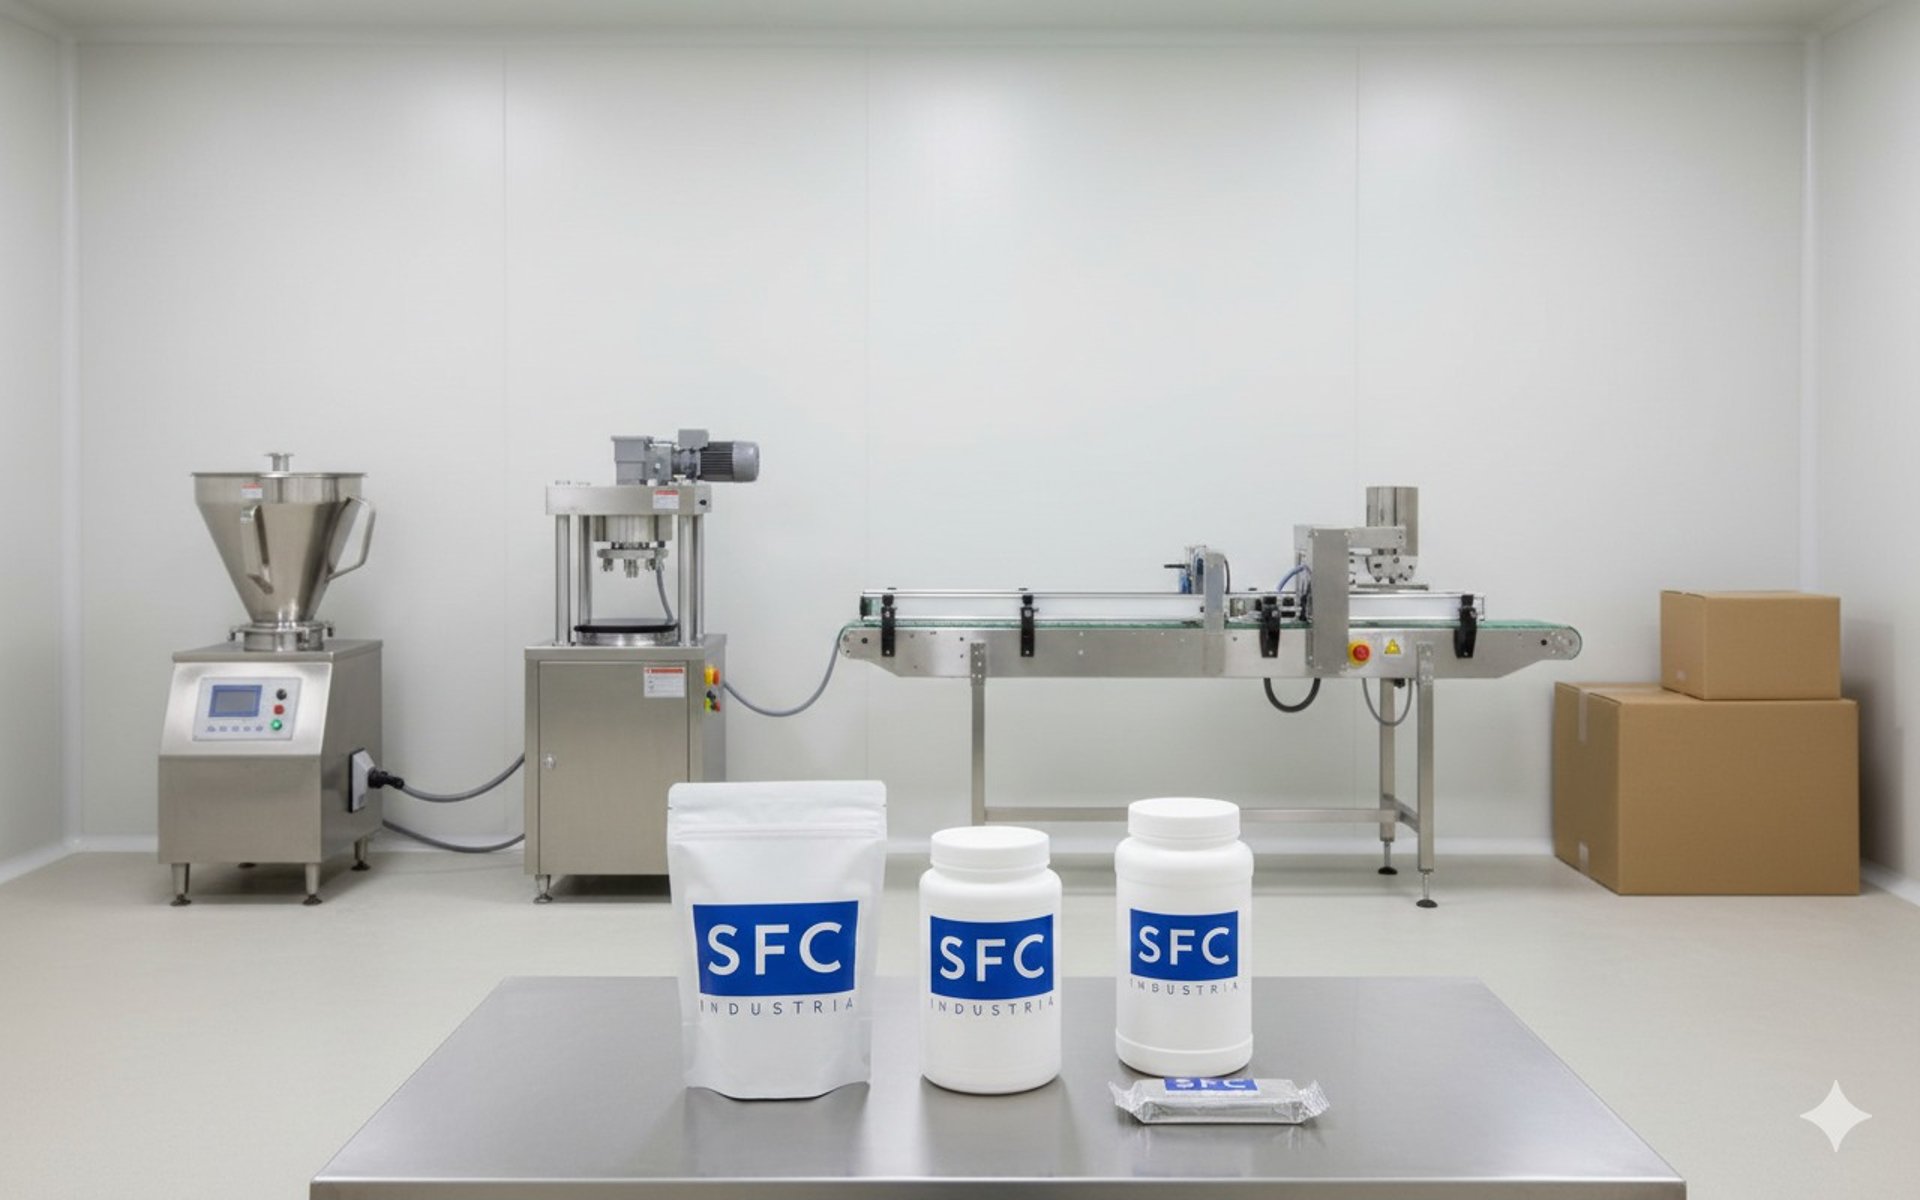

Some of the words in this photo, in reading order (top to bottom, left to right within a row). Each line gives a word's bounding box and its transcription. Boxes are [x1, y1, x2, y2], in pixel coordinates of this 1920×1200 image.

[708, 922, 842, 976] SFC
[940, 933, 1045, 982] SFC
[1138, 925, 1230, 966] SFC
[700, 997, 853, 1015] INDUSTRIA
[930, 996, 1054, 1016] INDUSTRIA
